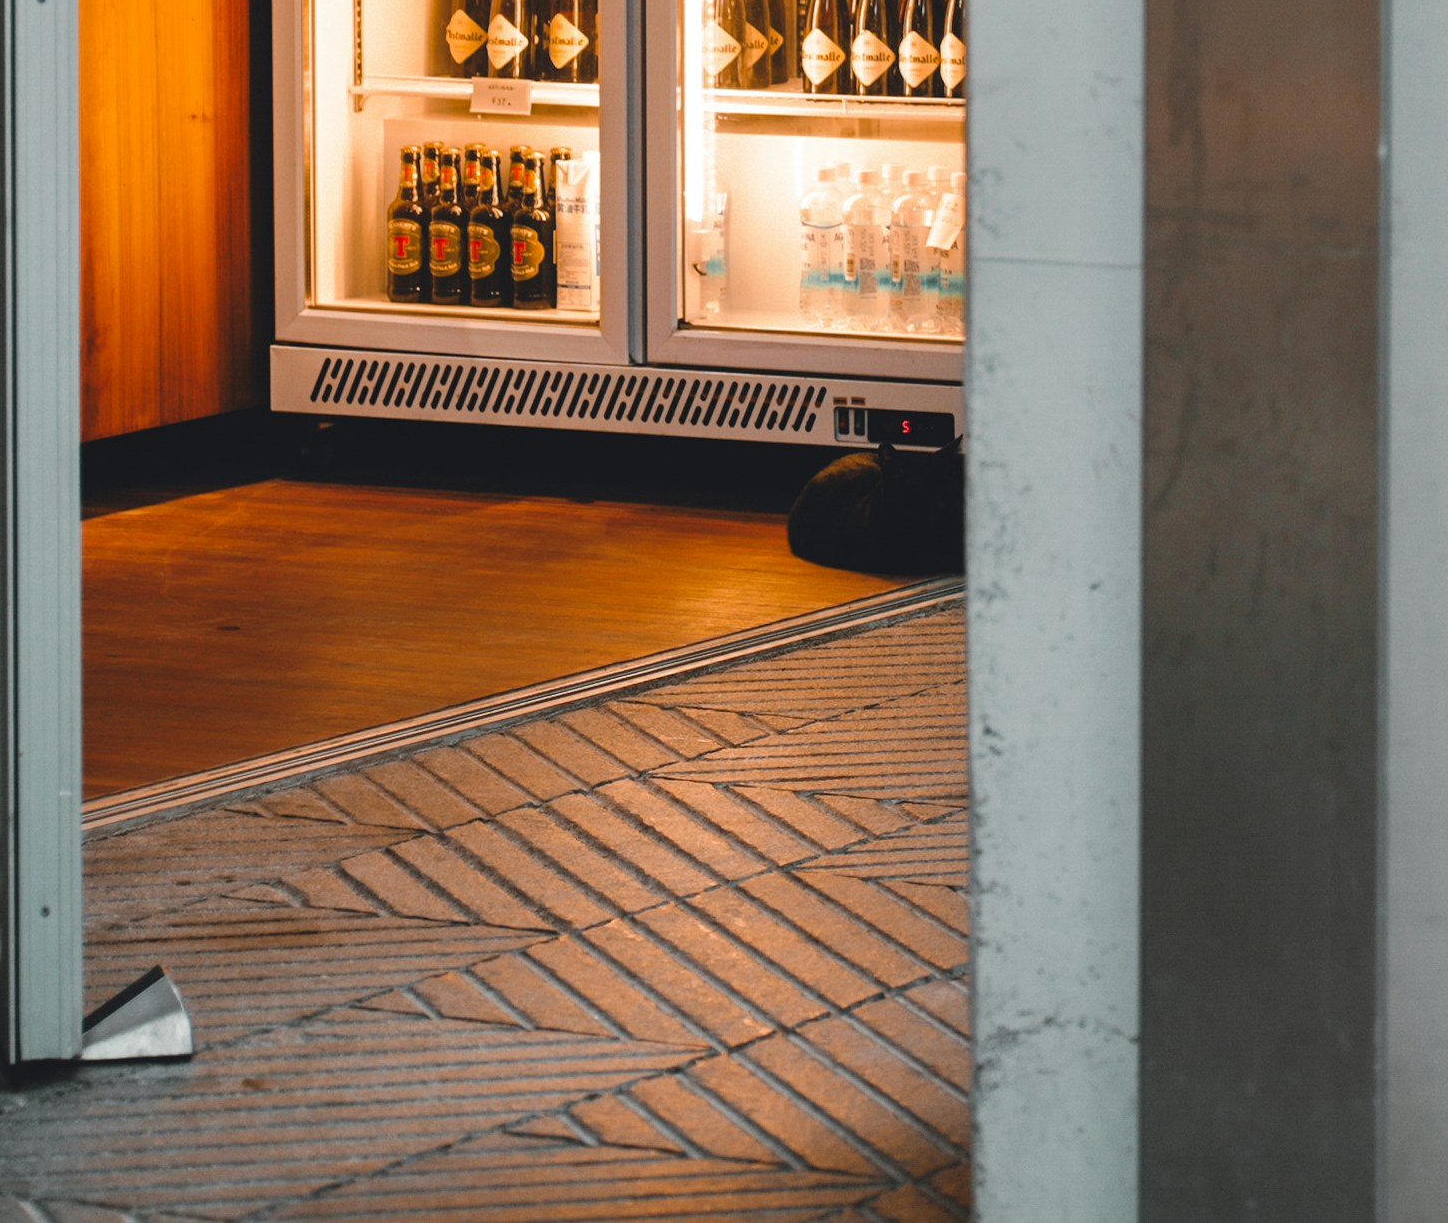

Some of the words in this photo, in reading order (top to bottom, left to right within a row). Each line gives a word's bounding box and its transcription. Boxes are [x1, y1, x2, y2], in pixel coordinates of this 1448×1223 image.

[394, 235, 410, 257] T
[432, 237, 449, 260] T
[470, 240, 483, 262] T
[514, 241, 526, 264] T
